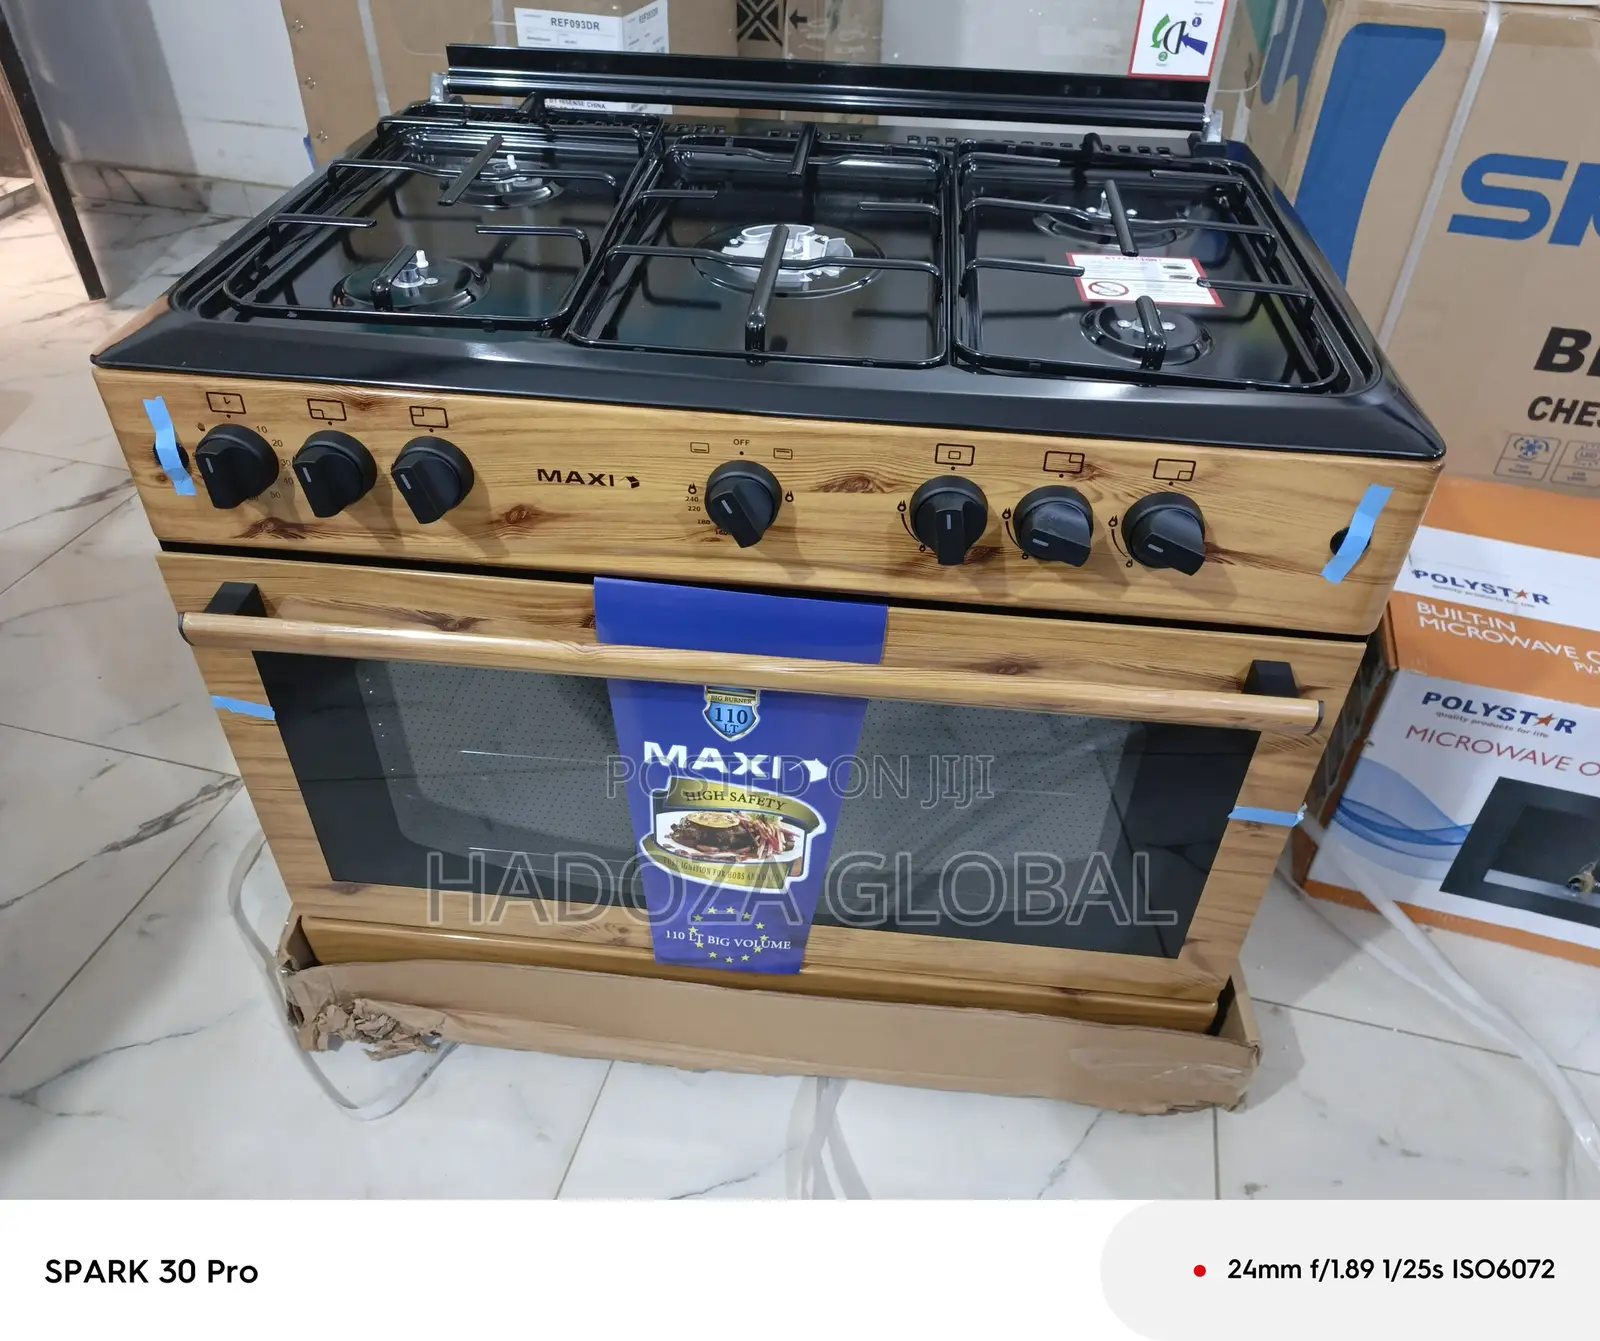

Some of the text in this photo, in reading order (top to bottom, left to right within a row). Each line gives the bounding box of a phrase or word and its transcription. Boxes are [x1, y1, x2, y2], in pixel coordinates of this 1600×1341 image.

[550, 17, 600, 31] REF093DR
[1526, 395, 1600, 428] CHE
[255, 425, 268, 434] 10
[271, 439, 283, 448] 20
[733, 438, 750, 446] OFF
[280, 458, 291, 467] 30
[537, 468, 615, 487] MAXI
[1416, 601, 1516, 633] BUILT-IN
[1418, 616, 1579, 660] MICROWAVE
[724, 696, 752, 704] BURNER
[715, 707, 748, 725] 110
[1435, 711, 1549, 739] quality products for life
[724, 723, 739, 733] LT
[1405, 724, 1574, 771] MICROWAVE
[643, 741, 782, 779] MAXI
[684, 789, 788, 812] HIGH SAFETY
[665, 930, 792, 950] 110 LT BIG VOLUME
